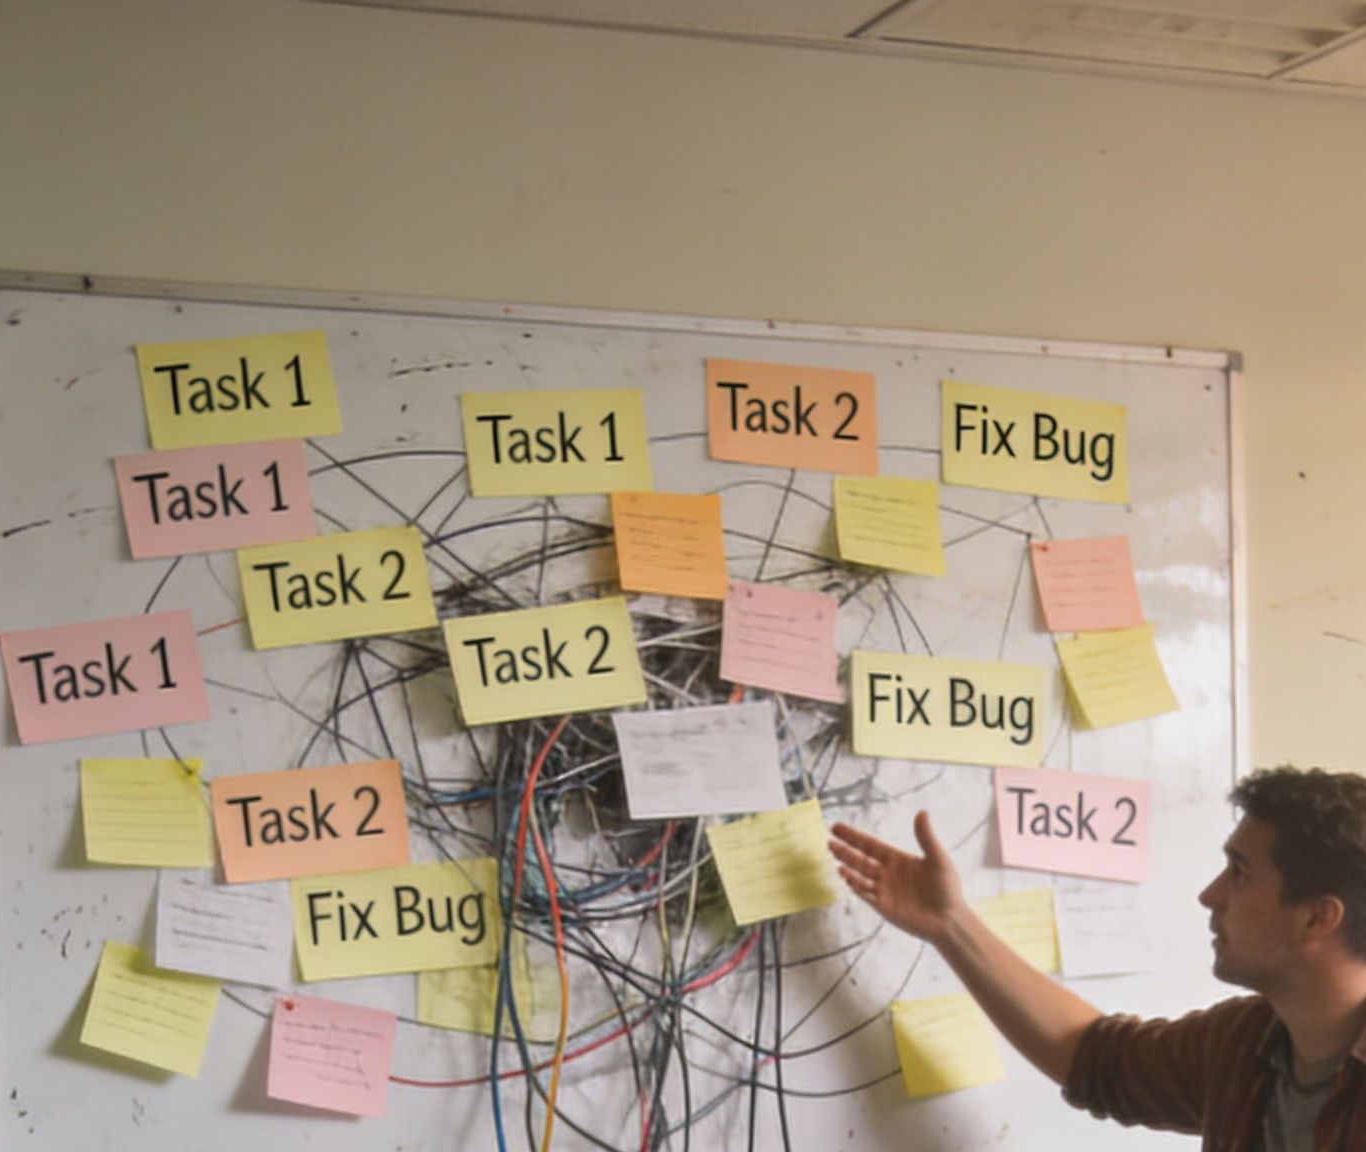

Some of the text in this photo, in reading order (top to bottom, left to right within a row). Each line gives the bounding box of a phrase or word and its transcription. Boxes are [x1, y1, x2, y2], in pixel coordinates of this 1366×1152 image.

[153, 354, 311, 416] Task 1
[715, 381, 860, 441] Task 2
[475, 411, 624, 465] Task 1
[954, 402, 1115, 482] Fix Bug
[131, 461, 289, 525] Task 1
[252, 549, 411, 613] Task 2
[17, 637, 177, 705] Task 1
[462, 625, 615, 688] Task 2
[868, 672, 1034, 746] Fix Bug
[225, 788, 340, 848] Task
[353, 785, 385, 837] 2
[1005, 786, 1137, 847] Task 2
[306, 890, 379, 946] Fix
[393, 885, 488, 947] Bug
